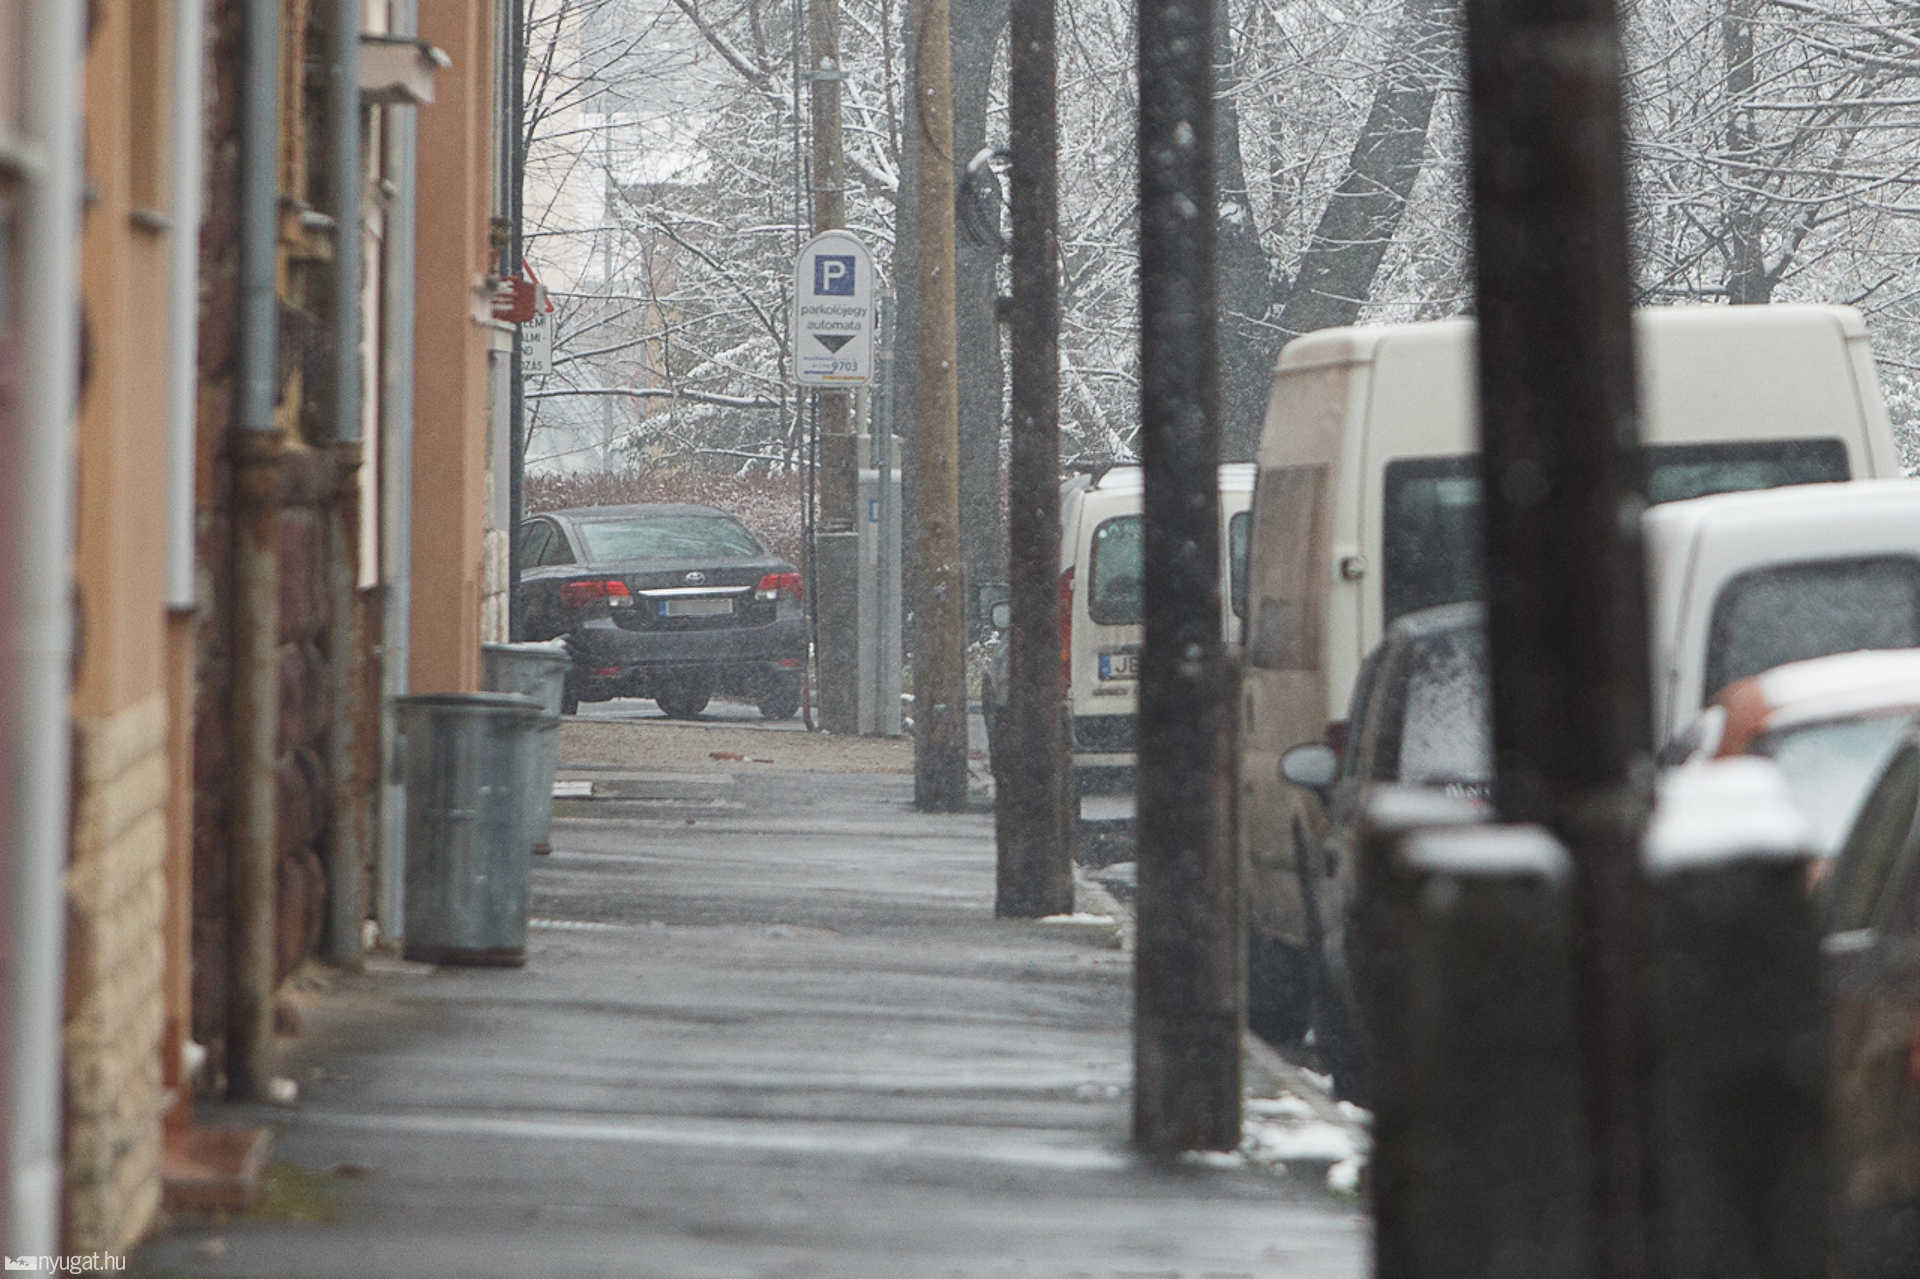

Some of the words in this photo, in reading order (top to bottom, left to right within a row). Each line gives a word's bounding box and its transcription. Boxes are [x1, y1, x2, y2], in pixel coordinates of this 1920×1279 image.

[824, 261, 846, 290] P
[807, 320, 862, 330] automata
[831, 360, 858, 372] 9703
